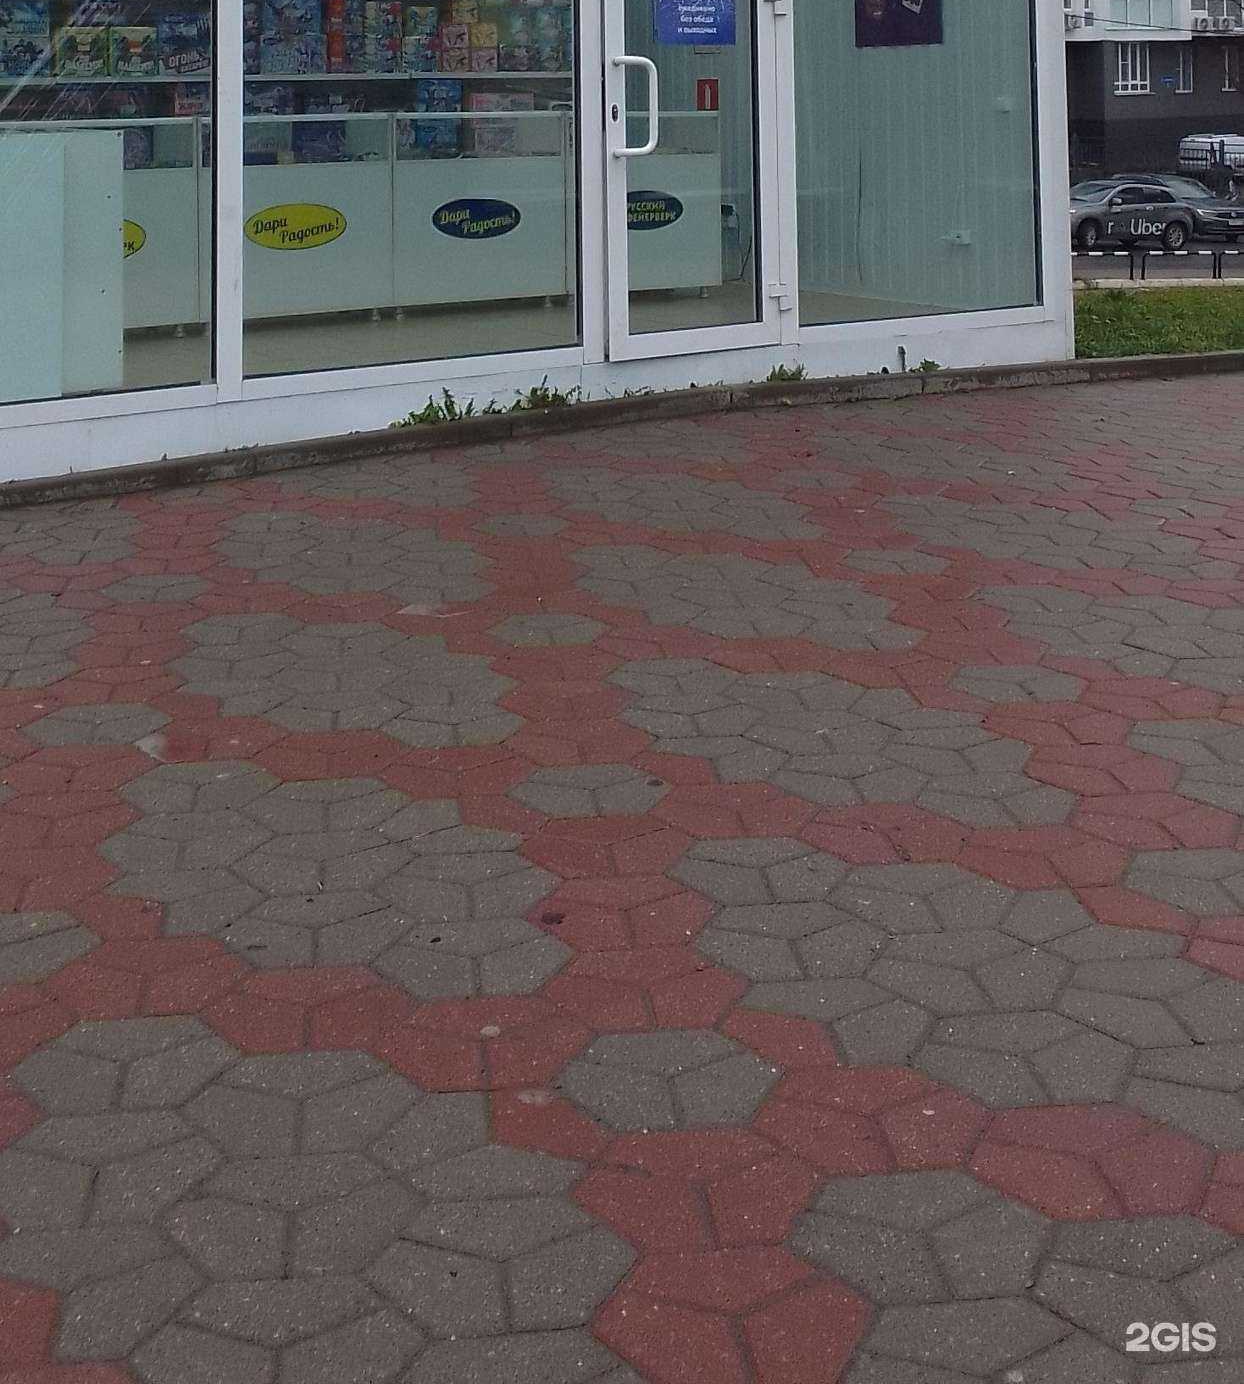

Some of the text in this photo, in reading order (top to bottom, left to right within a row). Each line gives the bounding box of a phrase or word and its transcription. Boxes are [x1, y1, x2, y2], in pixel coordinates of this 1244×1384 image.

[681, 14, 714, 23] без обеда
[440, 209, 470, 225] Дари
[253, 217, 288, 235] Дари
[280, 217, 339, 243] Радость!
